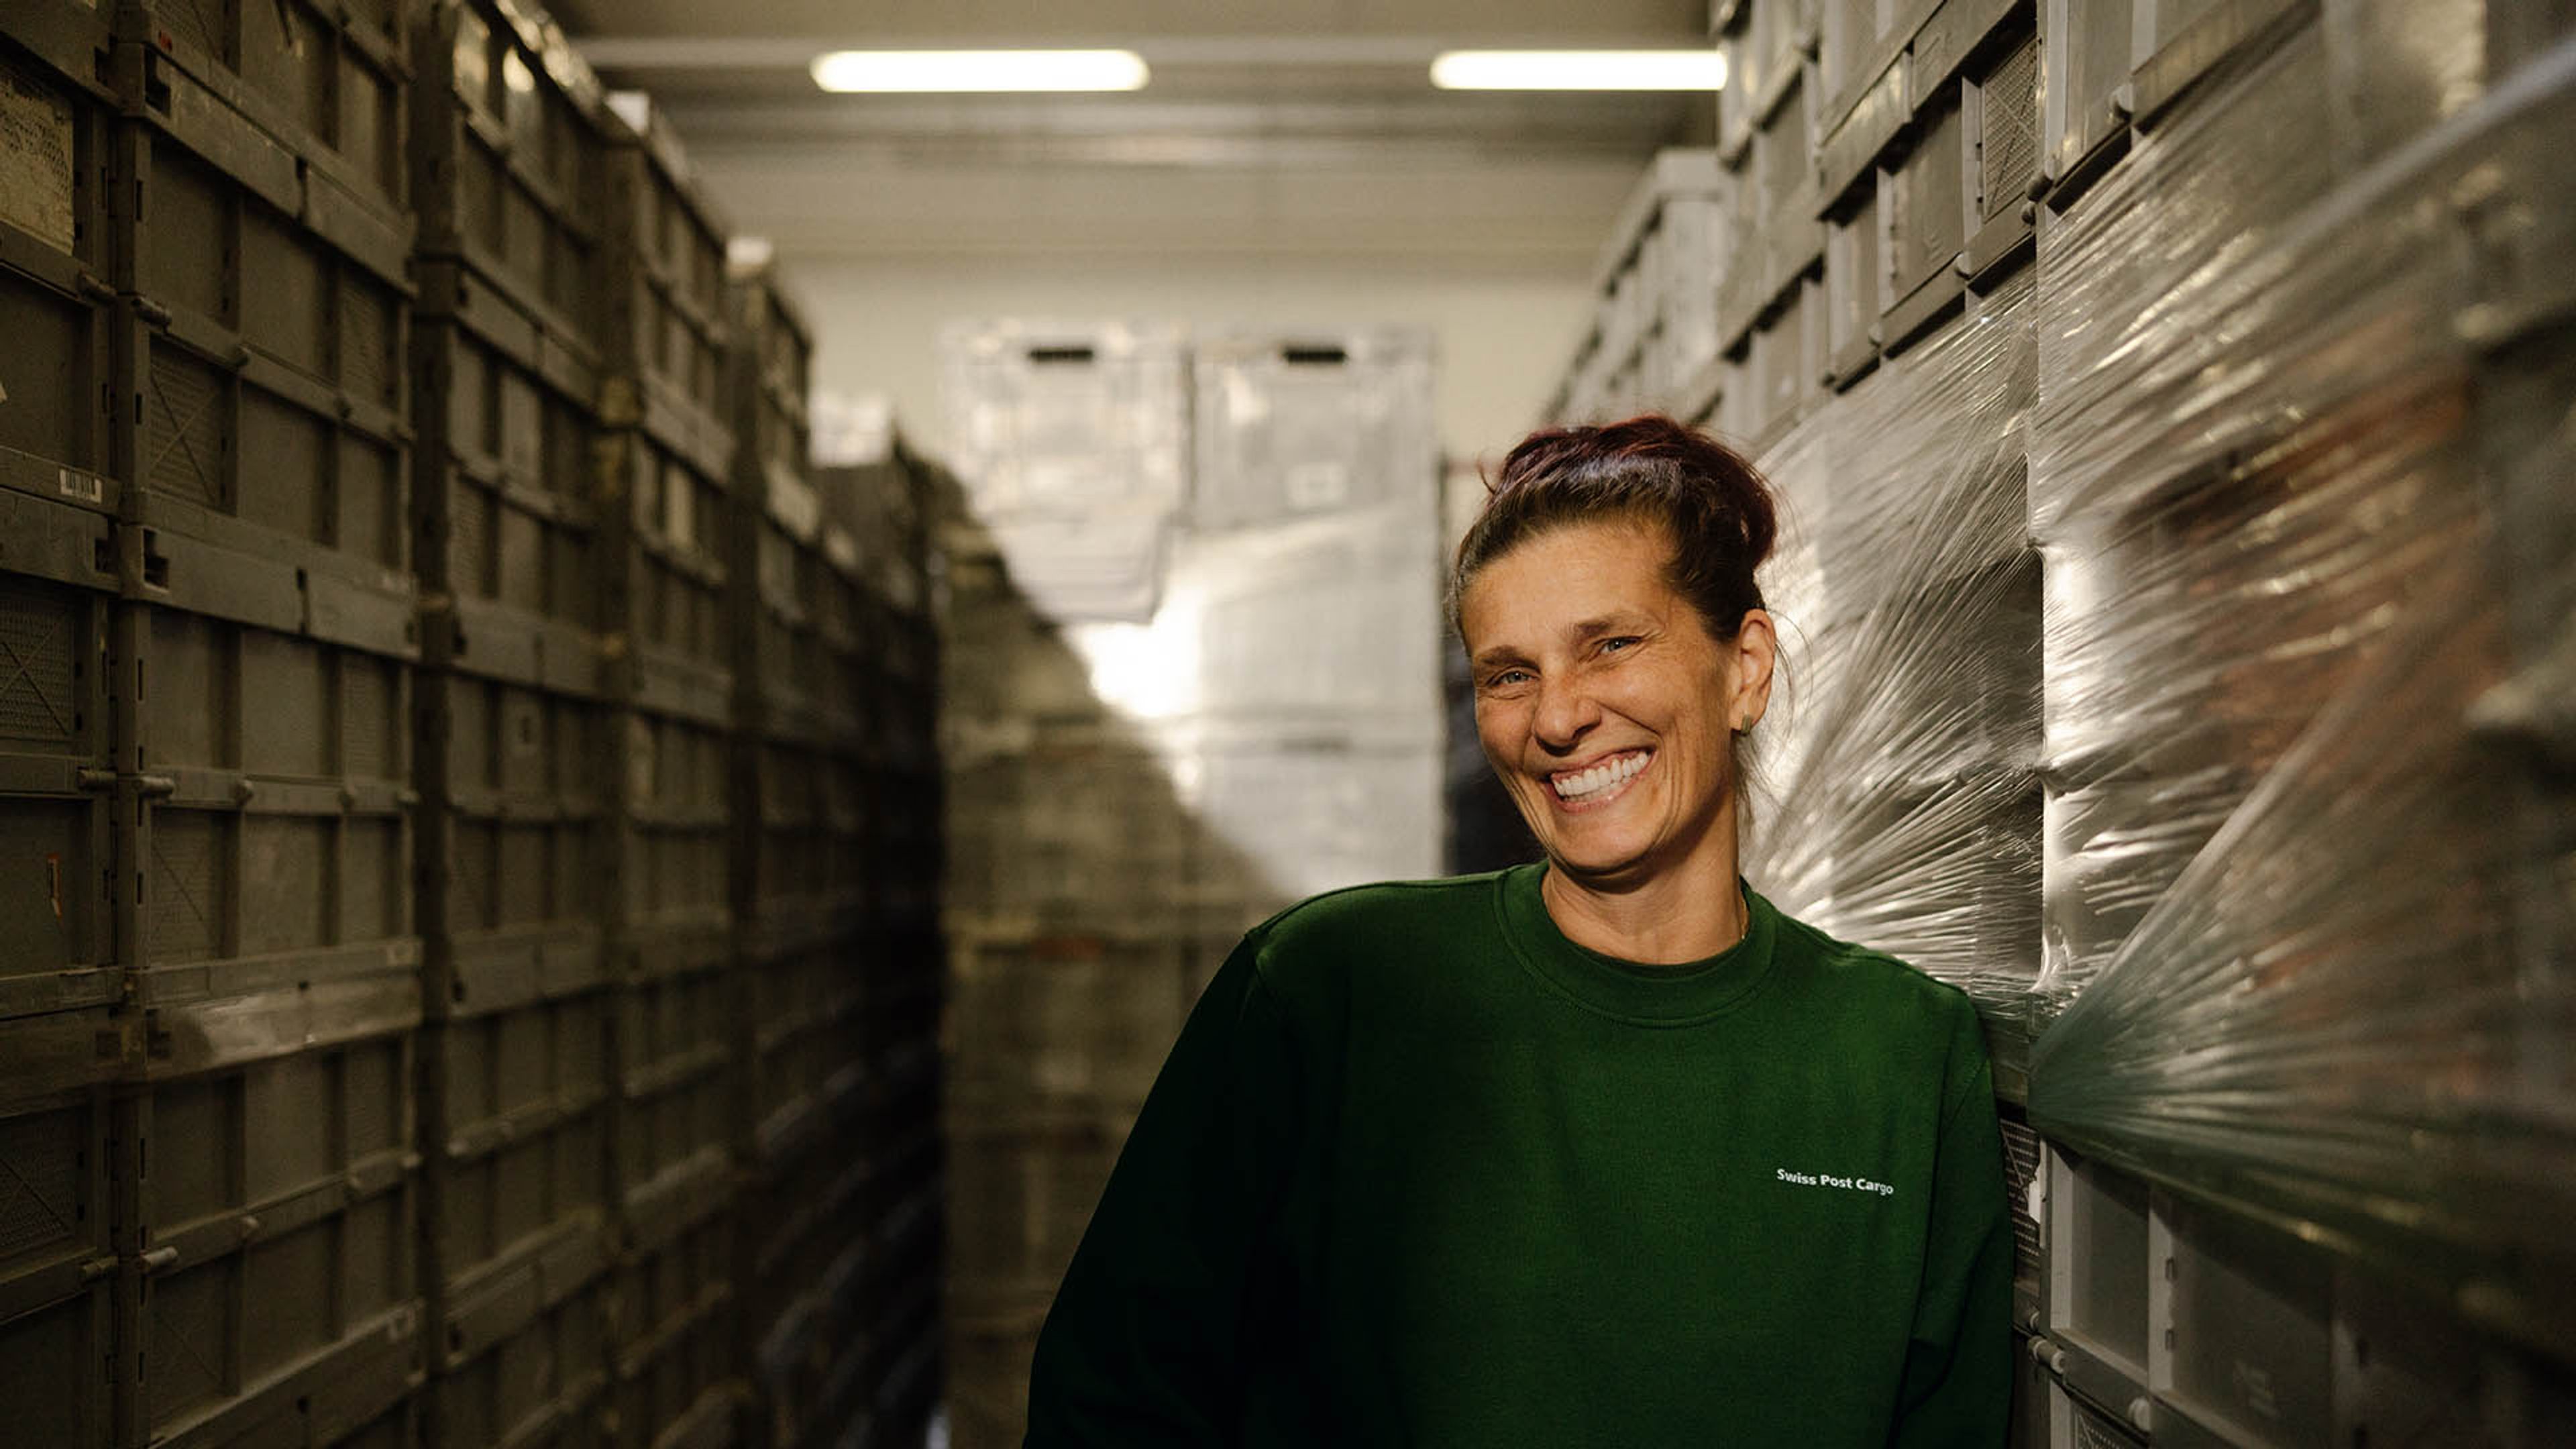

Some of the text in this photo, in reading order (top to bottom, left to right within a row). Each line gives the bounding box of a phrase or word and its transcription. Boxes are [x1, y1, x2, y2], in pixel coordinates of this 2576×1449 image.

[1777, 1169, 1894, 1195] Swiss Post Cargo
